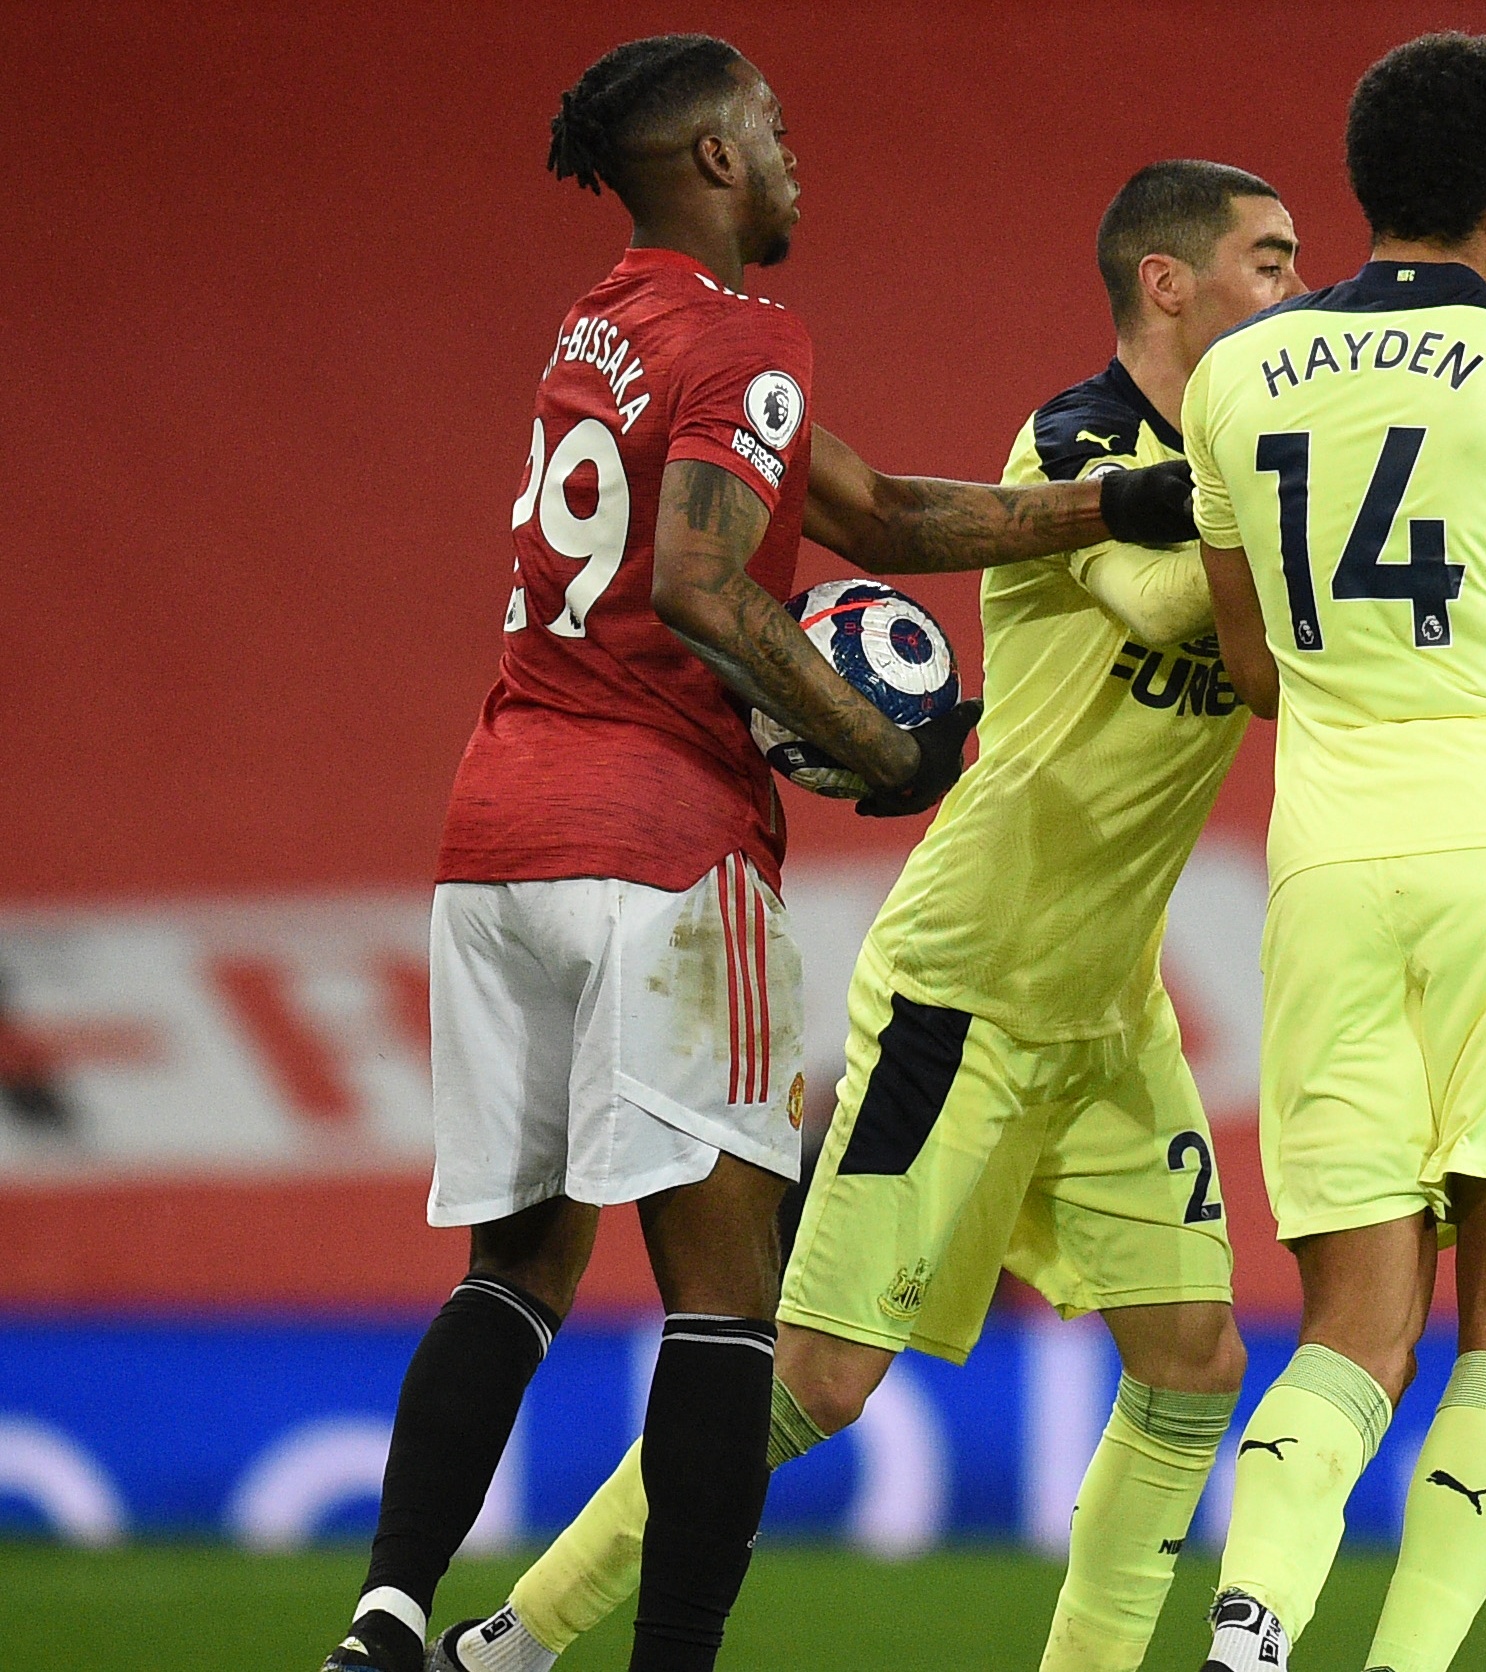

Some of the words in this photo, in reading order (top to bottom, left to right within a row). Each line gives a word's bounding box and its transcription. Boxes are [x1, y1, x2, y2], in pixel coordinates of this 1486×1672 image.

[1260, 329, 1485, 399] HAYDEN
[733, 429, 756, 449] No
[755, 444, 784, 478] room
[1254, 425, 1467, 652] 14
[1266, 1616, 1282, 1641] TAP
